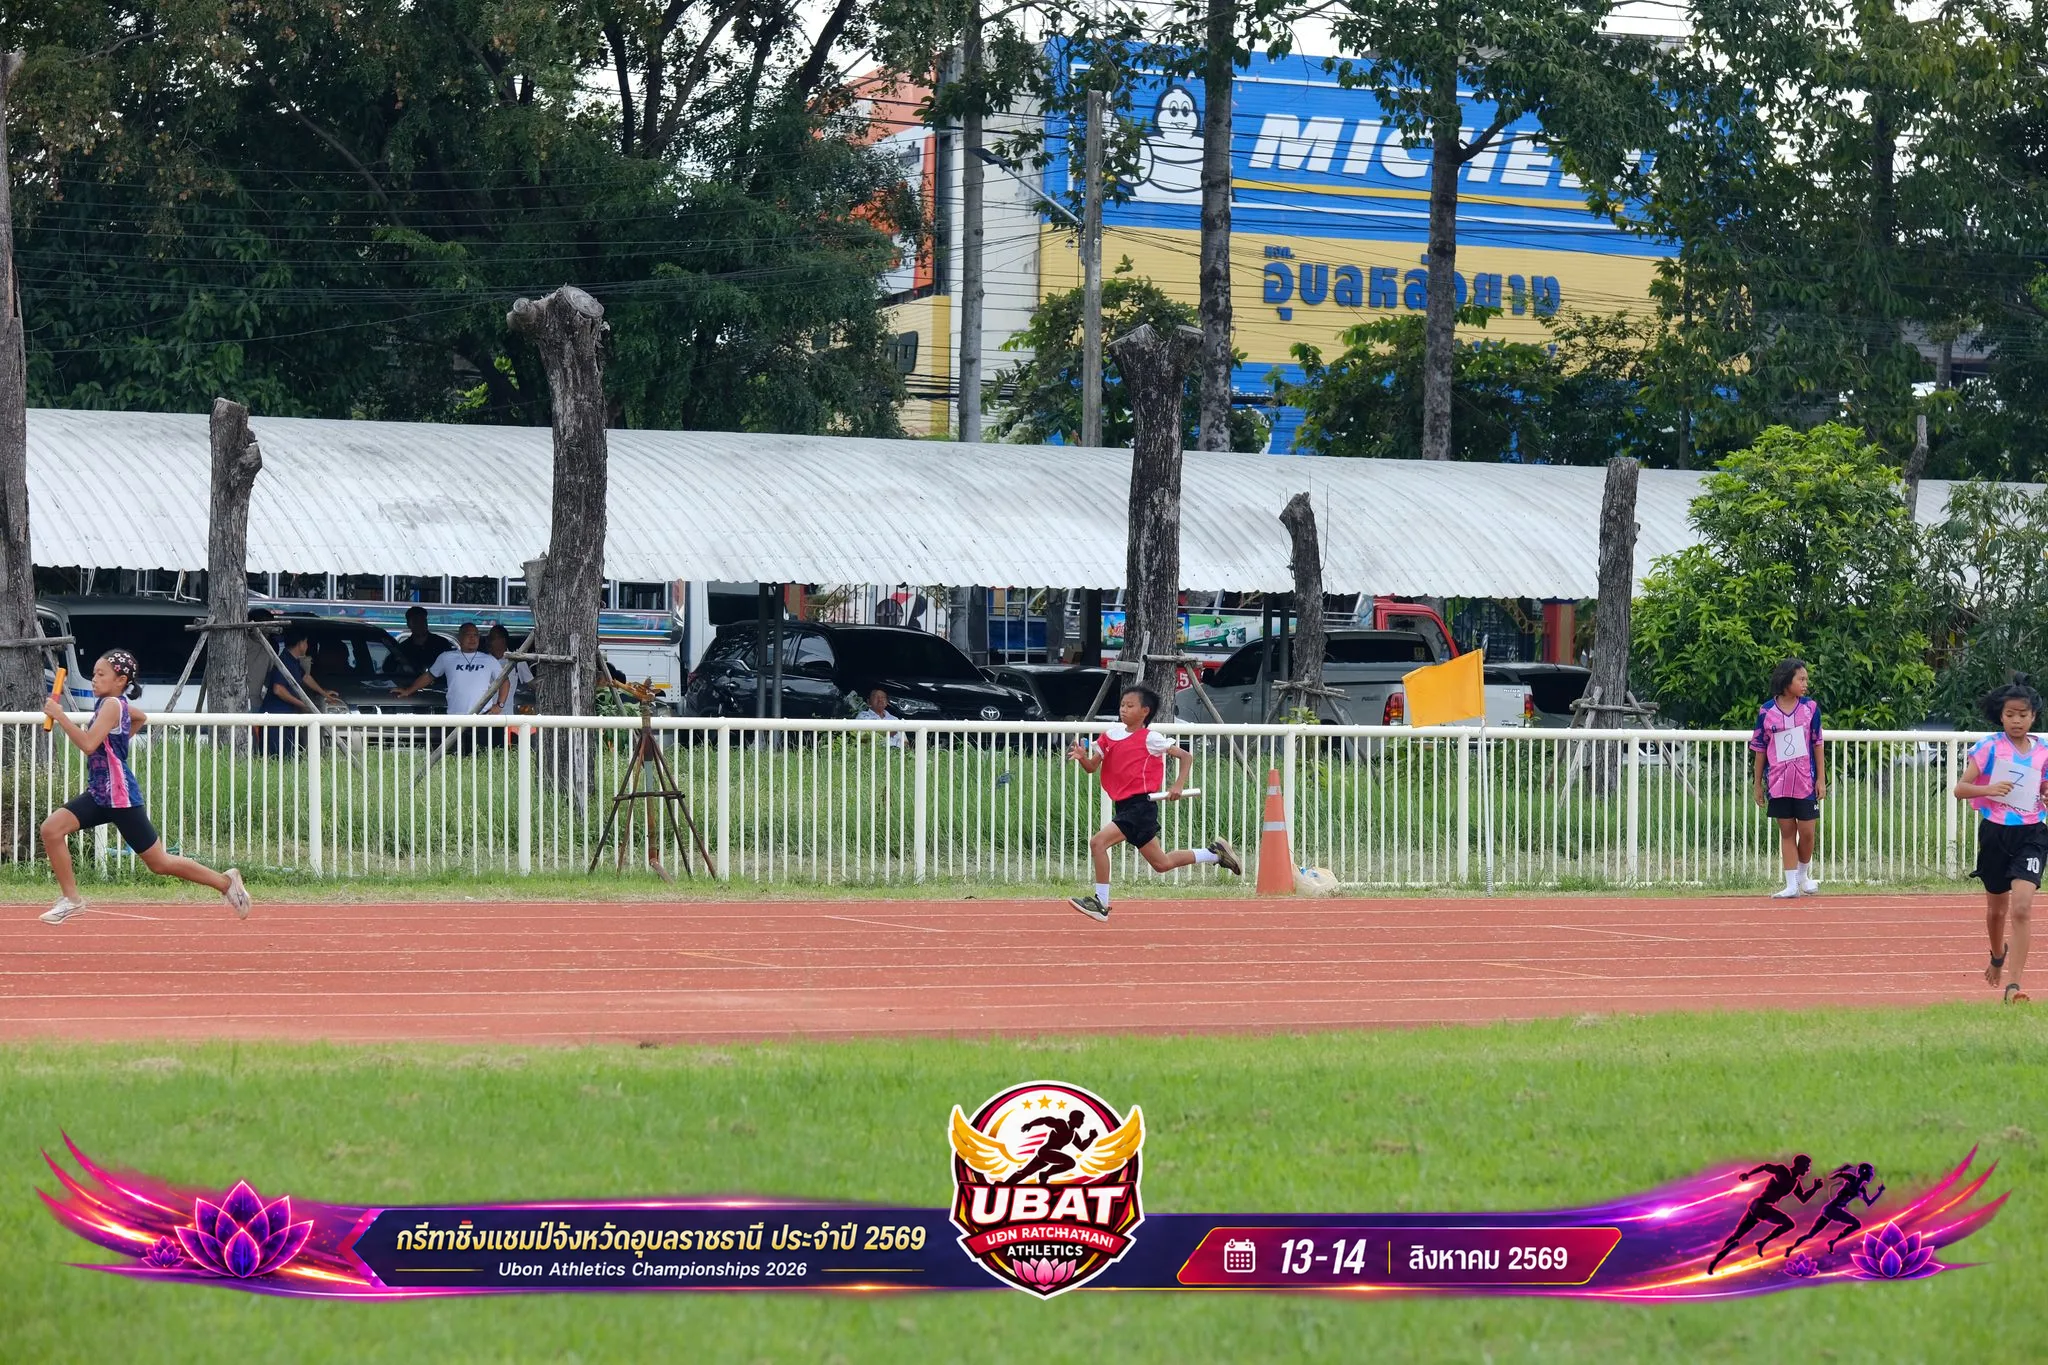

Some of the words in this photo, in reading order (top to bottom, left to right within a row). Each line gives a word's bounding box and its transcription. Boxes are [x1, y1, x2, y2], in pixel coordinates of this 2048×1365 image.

[1249, 113, 1662, 192] MICHE
[1784, 733, 1795, 757] 8
[2026, 857, 2040, 874] 10
